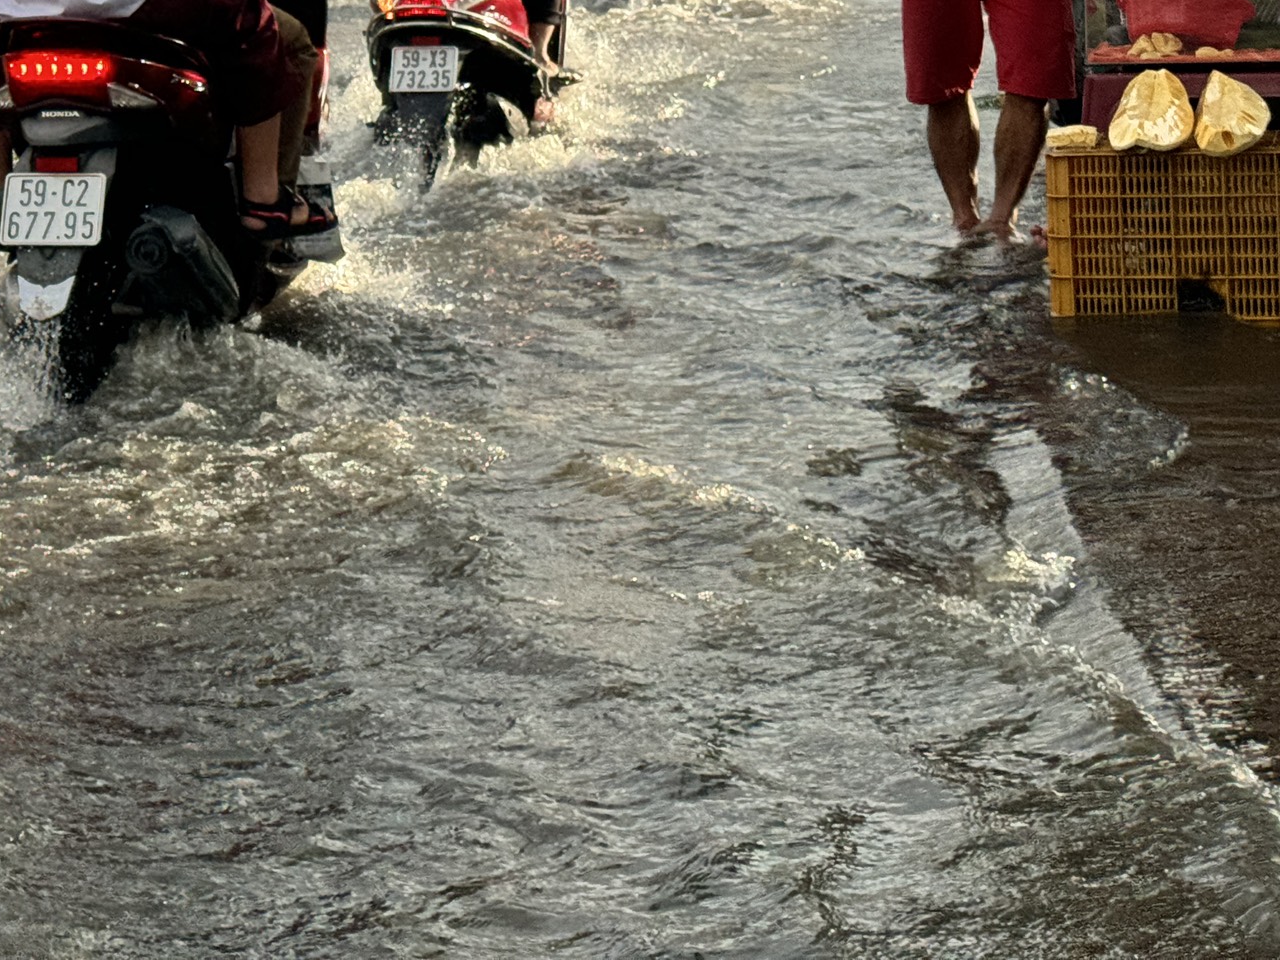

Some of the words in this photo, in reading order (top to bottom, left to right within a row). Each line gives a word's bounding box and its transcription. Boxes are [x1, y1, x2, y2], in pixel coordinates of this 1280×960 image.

[402, 50, 448, 68] 59-X3
[396, 70, 452, 89] 732.35
[19, 179, 90, 207] 59-C2
[7, 211, 95, 240] 677.95
